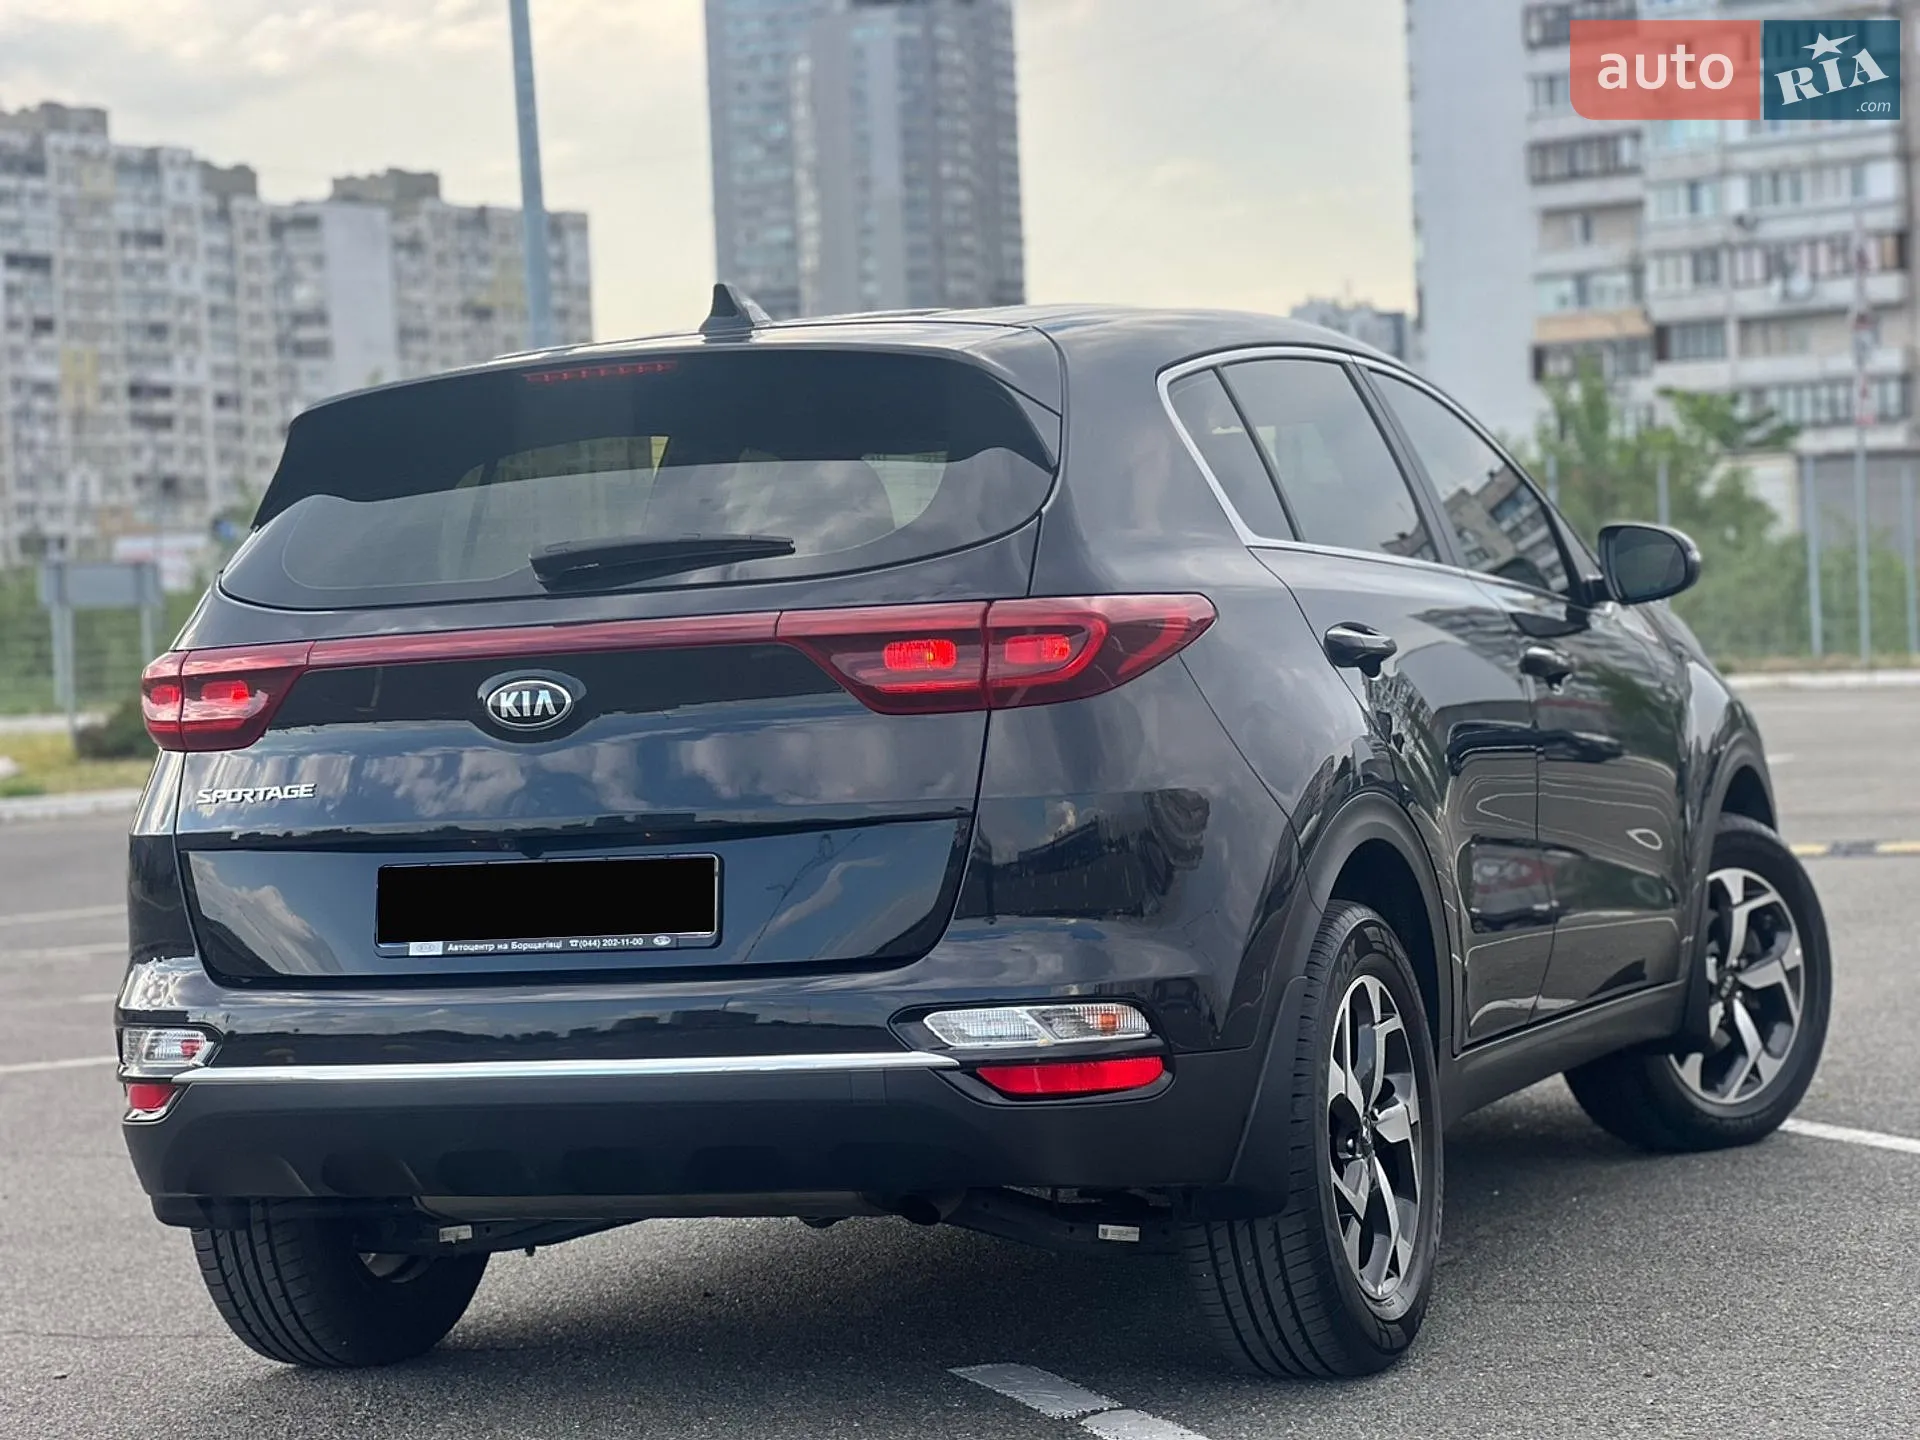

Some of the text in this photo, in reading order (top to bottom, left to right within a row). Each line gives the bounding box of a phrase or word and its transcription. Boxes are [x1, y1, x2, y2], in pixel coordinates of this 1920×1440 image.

[499, 689, 557, 718] KIA
[196, 783, 316, 804] SPORTAGE
[447, 942, 495, 952] Автоцентр
[497, 942, 508, 950] на
[510, 940, 563, 952] Борщагівці
[602, 937, 644, 947] 202-11-00
